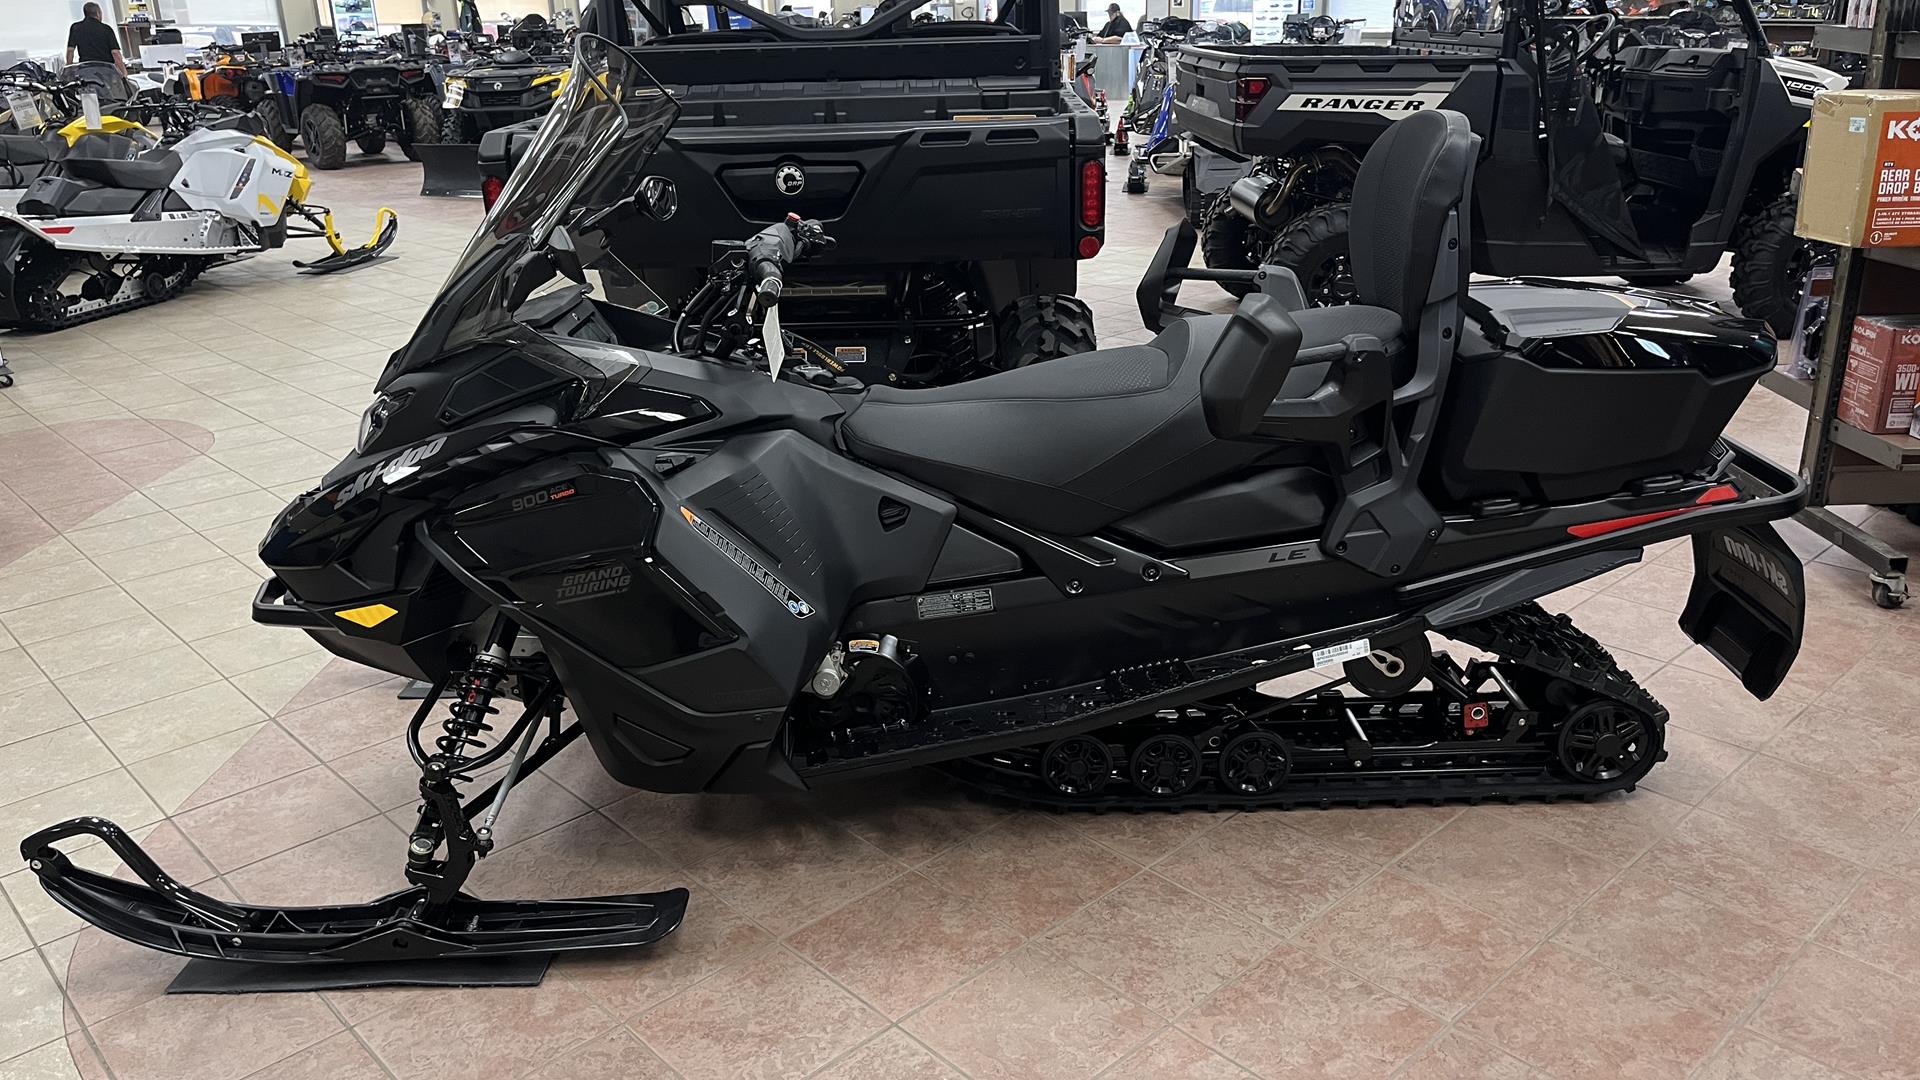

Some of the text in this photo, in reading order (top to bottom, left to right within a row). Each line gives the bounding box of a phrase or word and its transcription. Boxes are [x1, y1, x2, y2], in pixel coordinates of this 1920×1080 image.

[1300, 98, 1425, 111] RANGER
[1880, 169, 1910, 182] REAR
[1878, 182, 1910, 194] DROP
[512, 490, 549, 511] 900
[550, 488, 575, 500] TURBO
[1268, 548, 1310, 563] LE
[562, 566, 624, 587] GRAND
[556, 575, 632, 599] TOURING
